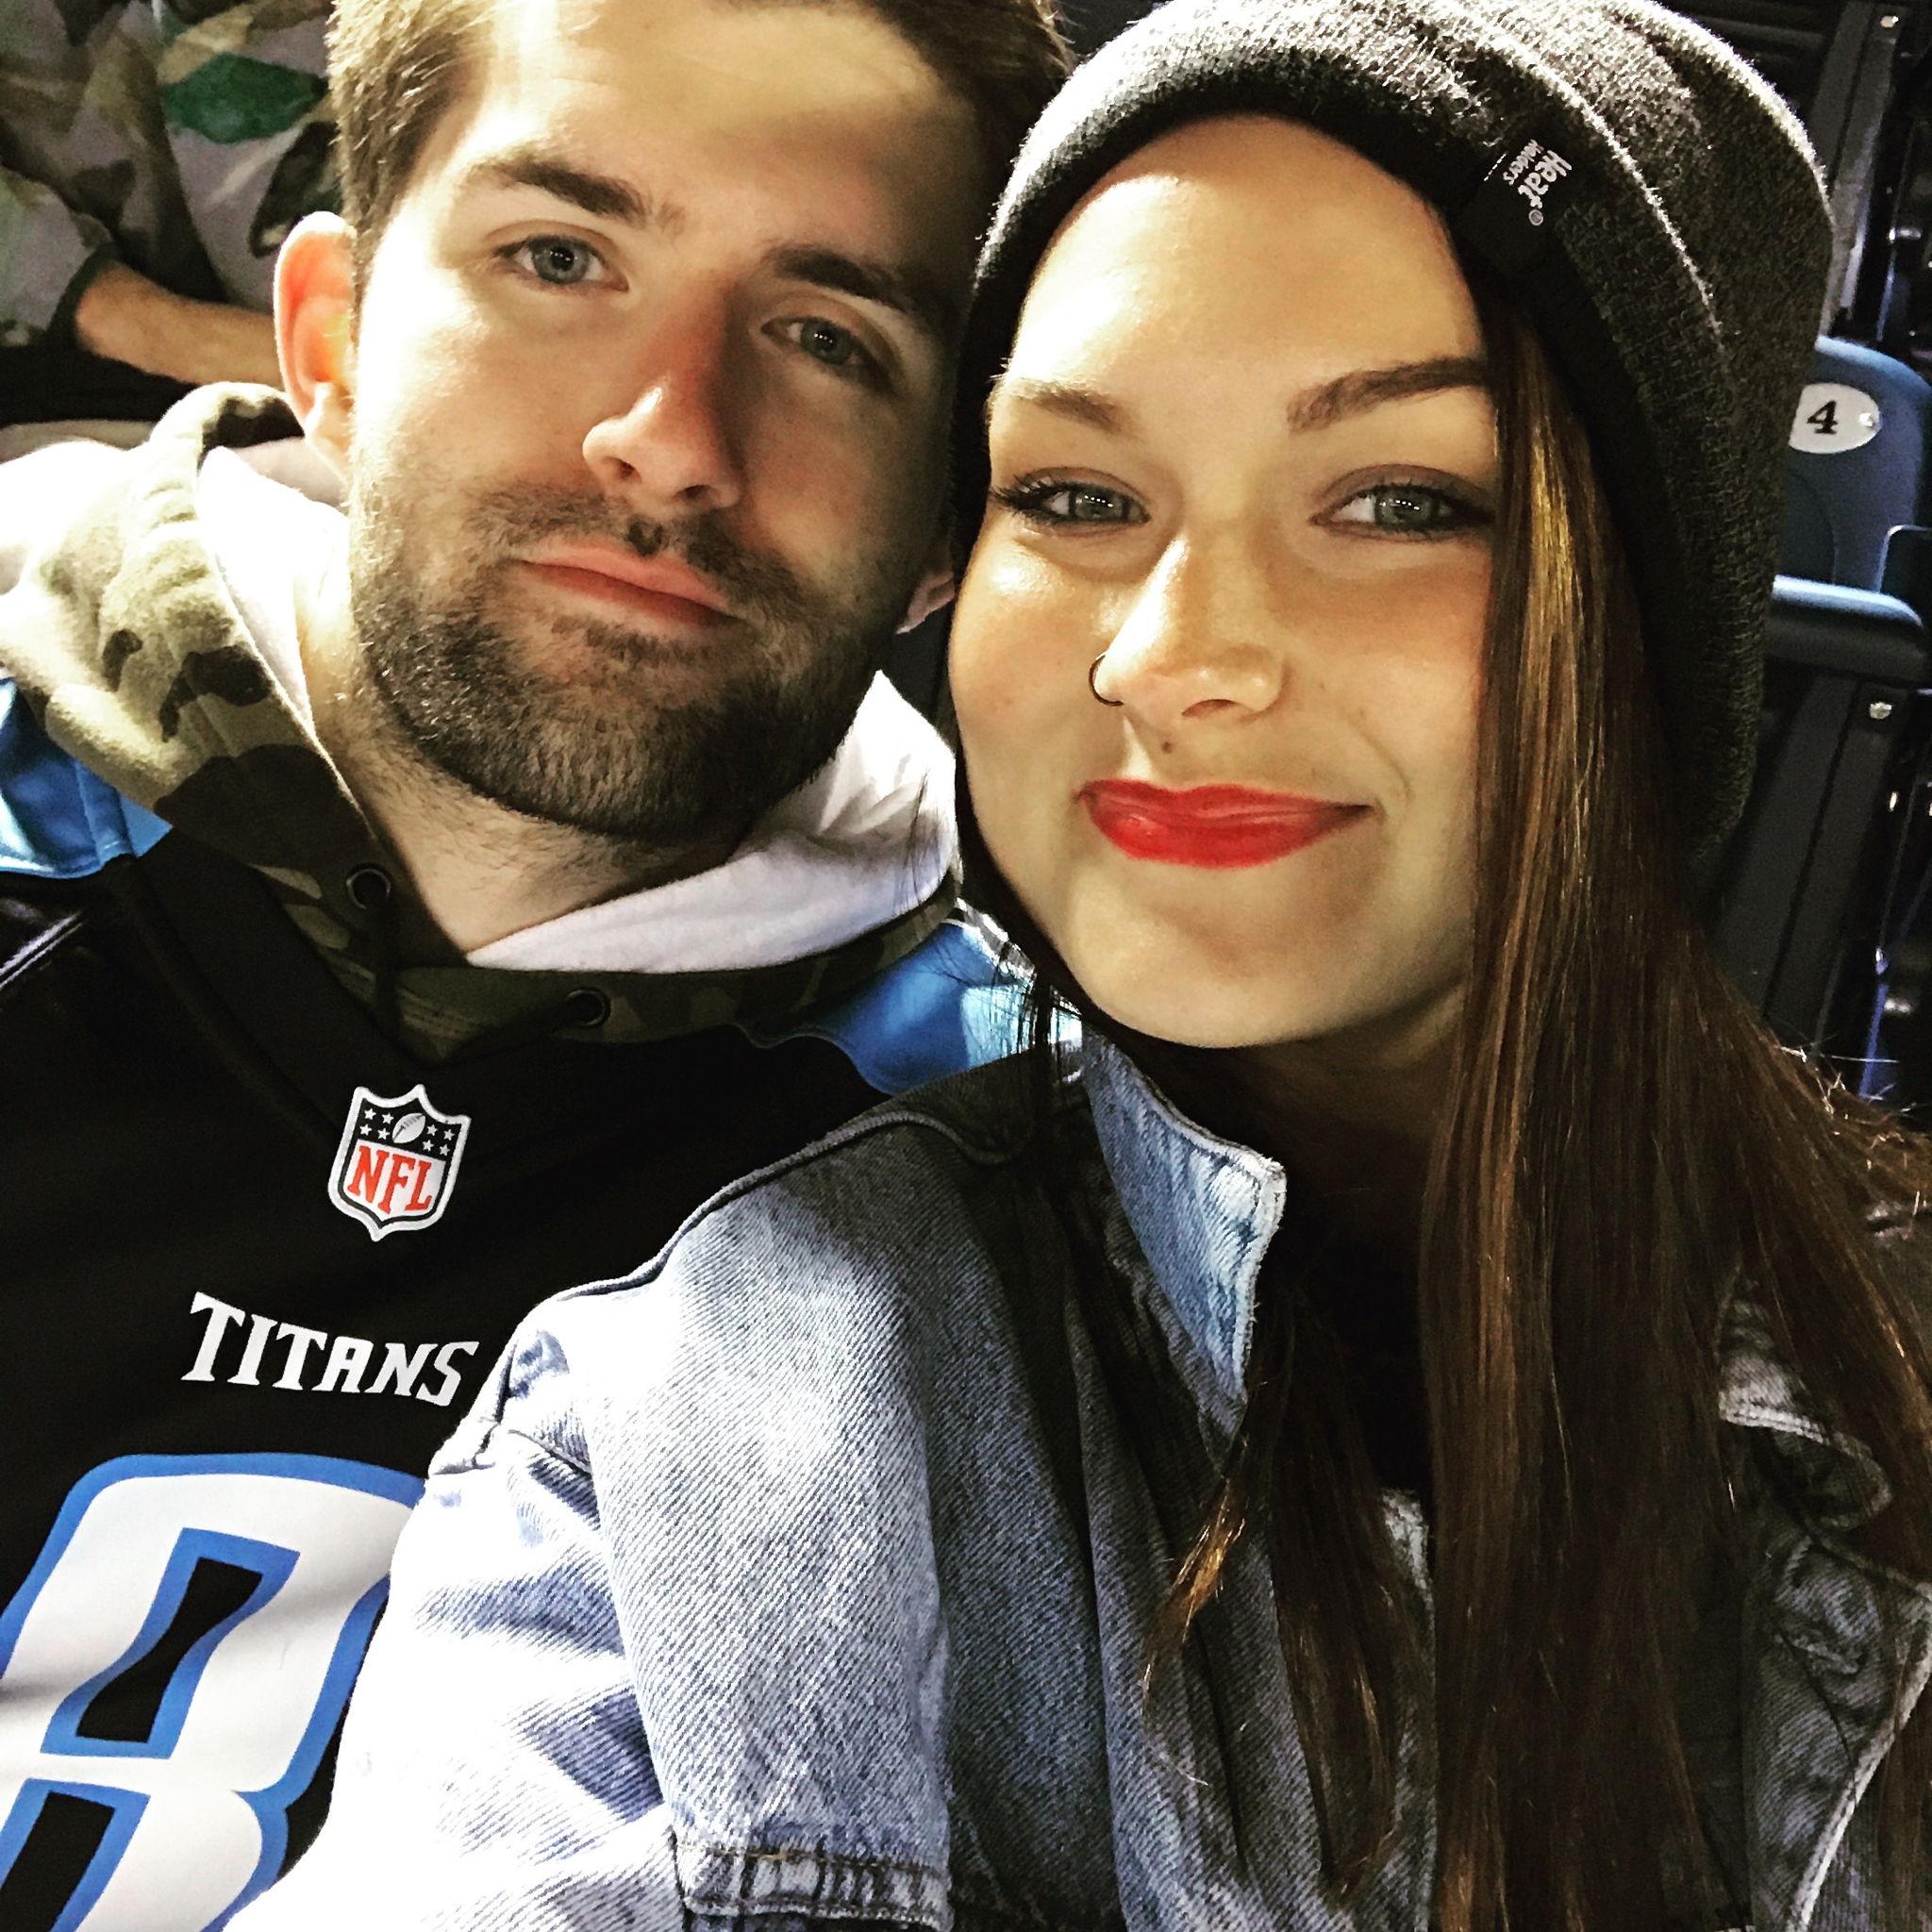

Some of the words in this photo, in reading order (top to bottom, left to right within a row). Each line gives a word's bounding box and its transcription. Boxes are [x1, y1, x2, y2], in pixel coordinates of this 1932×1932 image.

[1518, 150, 1573, 208] Heat
[1806, 399, 1839, 435] 4
[347, 1144, 432, 1214] NFL
[180, 1291, 480, 1407] TITANS
